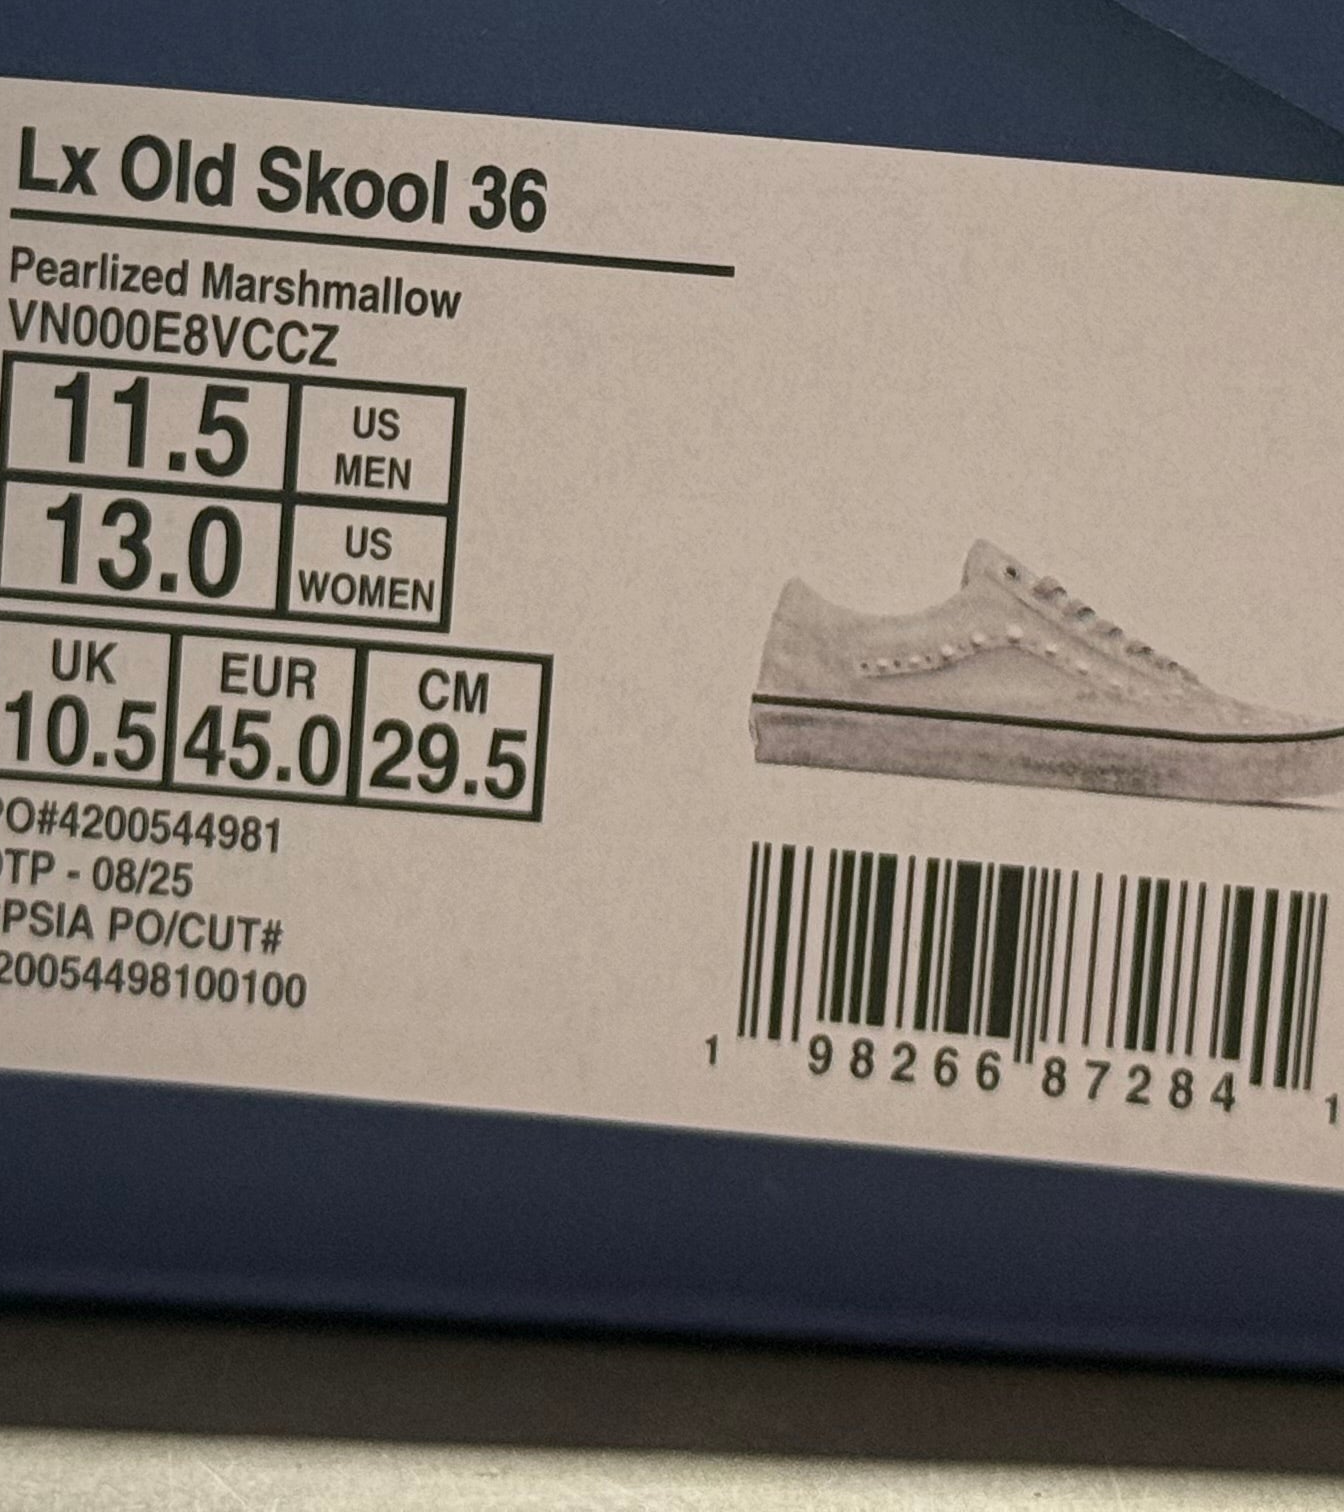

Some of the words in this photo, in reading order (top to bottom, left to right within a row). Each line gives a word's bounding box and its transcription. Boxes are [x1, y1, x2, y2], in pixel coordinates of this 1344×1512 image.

[17, 126, 100, 196] Lx
[120, 134, 236, 207] Old
[256, 145, 449, 225] Skool
[468, 164, 548, 234] 36
[9, 245, 189, 297] Pearlized
[202, 261, 462, 320] Marshmallow
[8, 297, 340, 367] VN000E8VCCZ
[53, 371, 249, 478] 11.5
[352, 405, 400, 442] US
[334, 453, 412, 491] MEN
[46, 493, 242, 599] 13.0
[345, 526, 392, 561] US
[298, 570, 435, 612] WOMEN
[51, 638, 116, 684] UK
[220, 652, 316, 700] EUR
[418, 668, 489, 715] CM
[4, 690, 156, 772] 10.5
[183, 705, 341, 787] 45.0
[369, 719, 527, 801] 29.5
[92, 856, 193, 898] 08/25
[108, 907, 284, 955] PO/CUT#
[705, 1034, 718, 1067] 1
[808, 1034, 1001, 1092] 98266
[1041, 1056, 1236, 1114] 87284
[1325, 1093, 1339, 1125] 1
